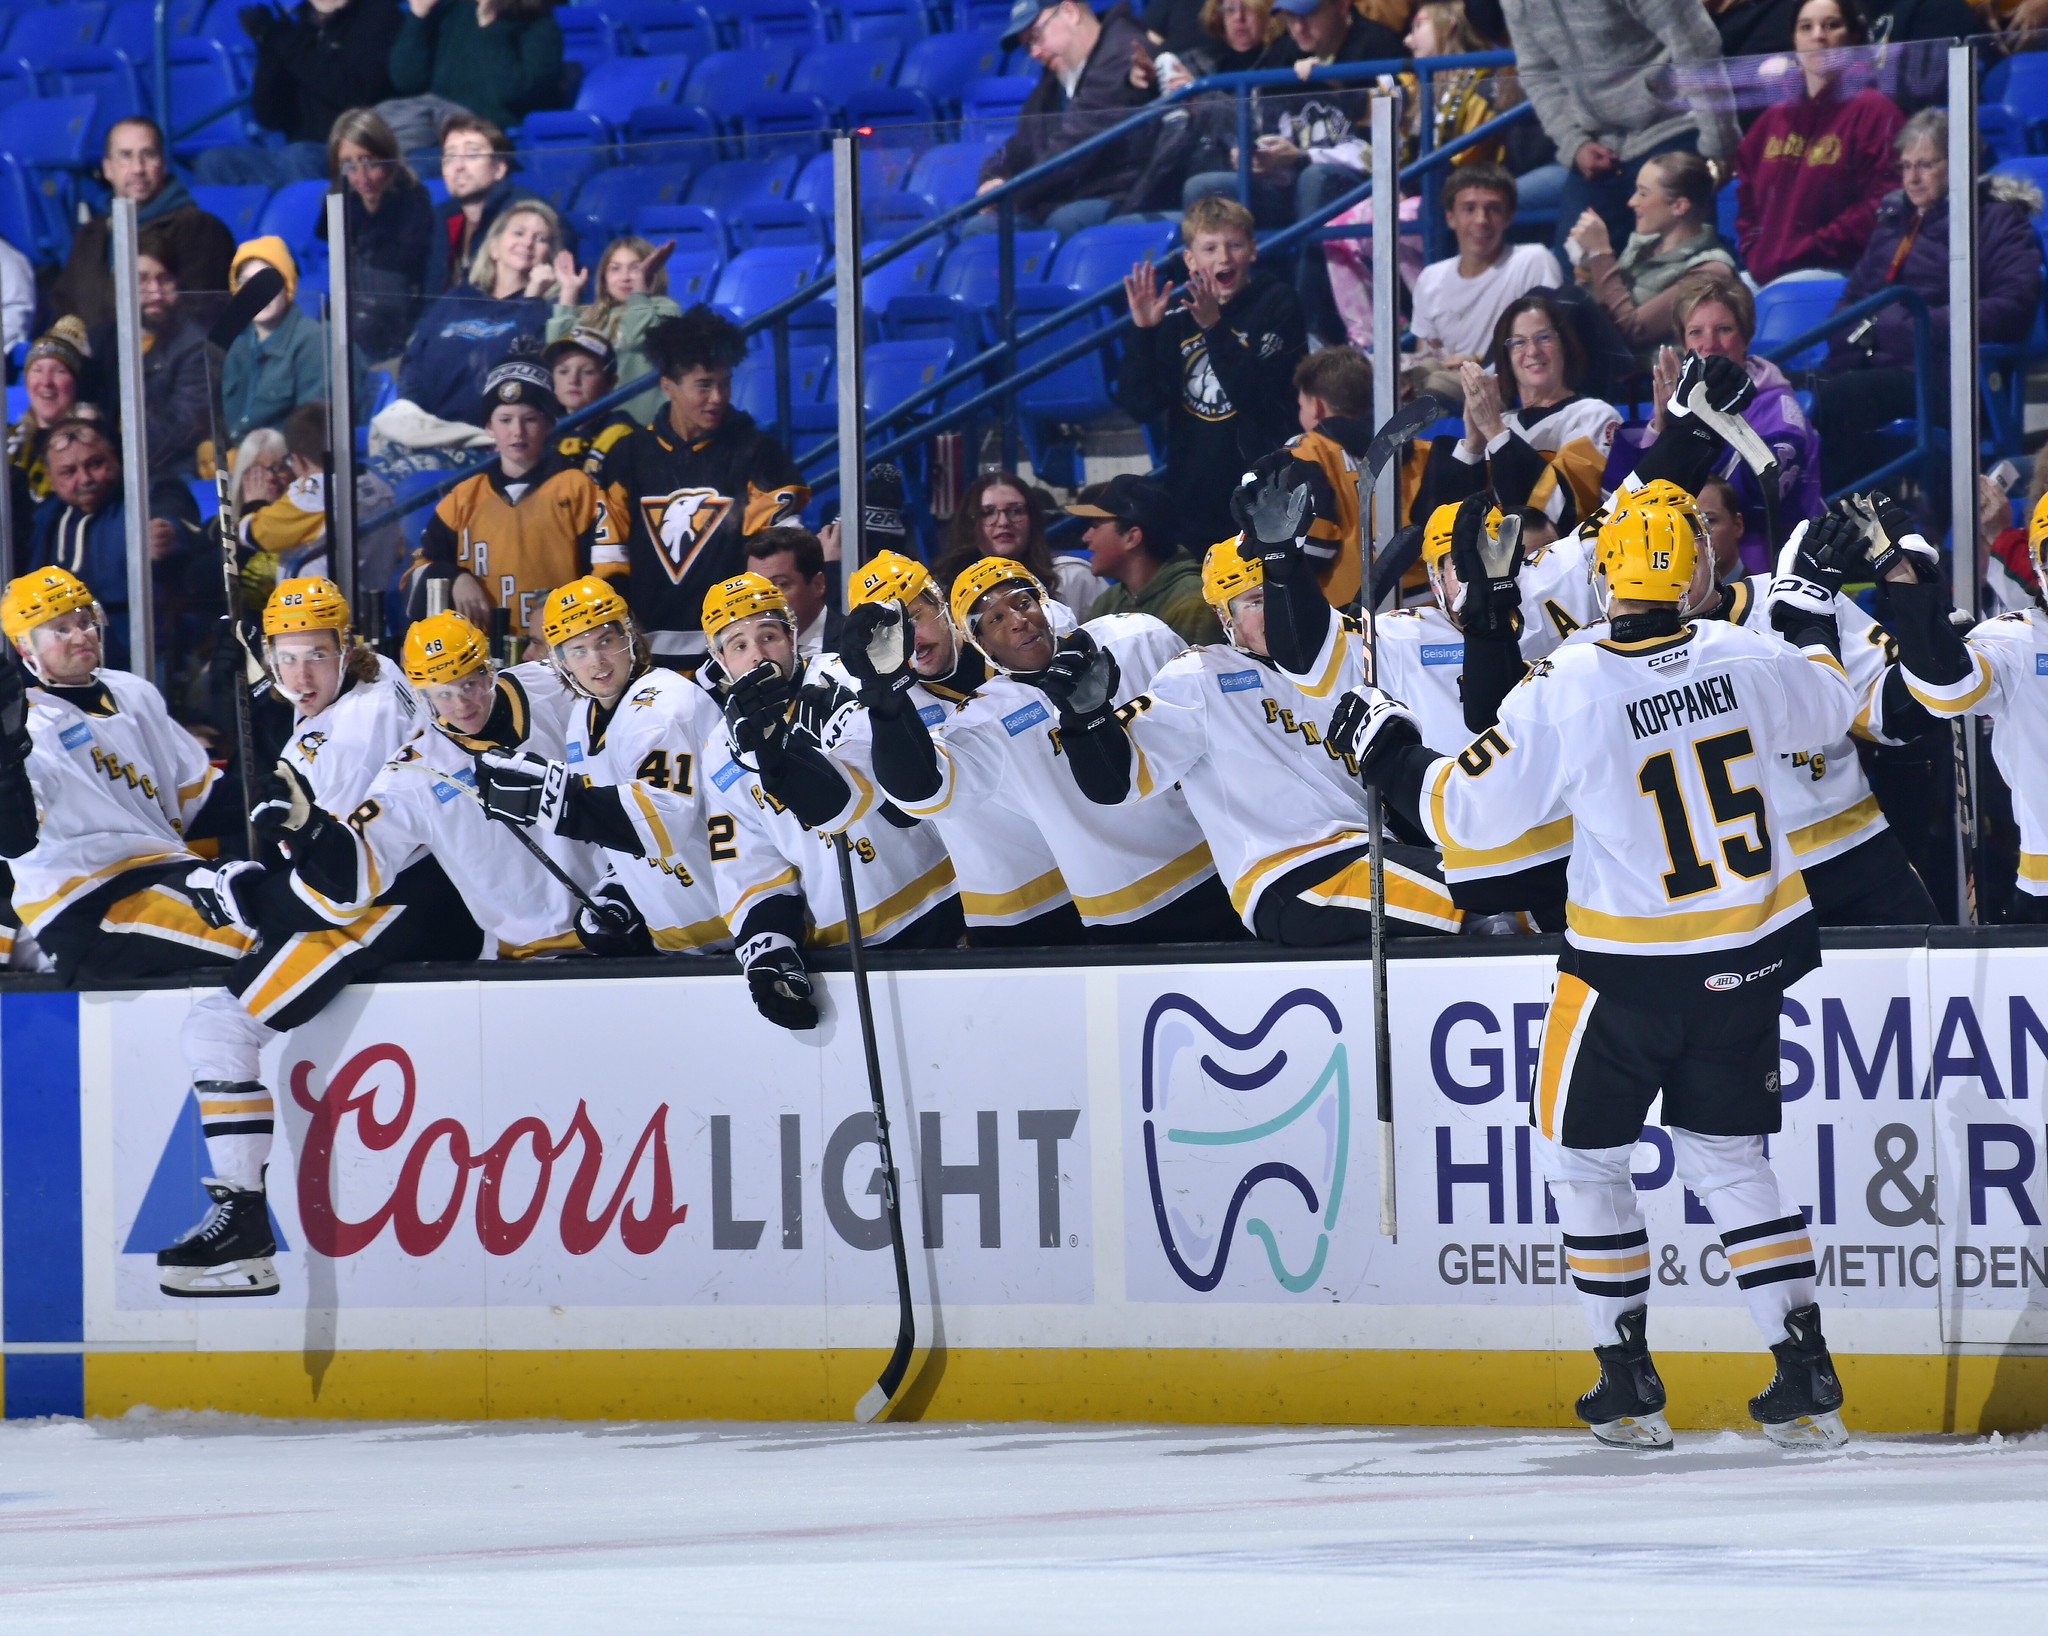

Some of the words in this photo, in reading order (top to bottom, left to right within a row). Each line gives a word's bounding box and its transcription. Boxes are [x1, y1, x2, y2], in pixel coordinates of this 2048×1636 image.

[1246, 561, 1264, 572] CC
[1651, 550, 1669, 570] 15
[864, 574, 879, 589] 61
[971, 565, 996, 583] CCM
[285, 593, 303, 606] 82
[561, 594, 576, 606] 41
[1768, 580, 1831, 601] CC
[561, 609, 588, 624] CCM
[1545, 599, 1581, 640] A
[425, 639, 443, 654] 48
[1422, 648, 1464, 659] Geisinge
[428, 660, 455, 674] CCM
[1648, 649, 1688, 667] CCM
[1221, 673, 1260, 687] Geisinger
[1625, 673, 1739, 740] KOPPANEN
[1005, 705, 1044, 730] Geisinger
[1456, 725, 1513, 778] 5
[637, 749, 694, 797] 41
[715, 764, 741, 788] Geising
[1636, 726, 1773, 902] 15
[707, 814, 738, 863] 2
[742, 936, 773, 966] CM
[1745, 959, 1783, 982] CCM
[1713, 976, 1735, 987] AHL
[289, 1042, 688, 1258] Coors
[710, 1109, 1082, 1251] LIGHT
[1866, 1122, 1946, 1228] &
[1439, 1243, 1573, 1287] GENE
[1657, 1243, 1689, 1287] &
[1700, 1243, 1940, 1289] CMETIC
